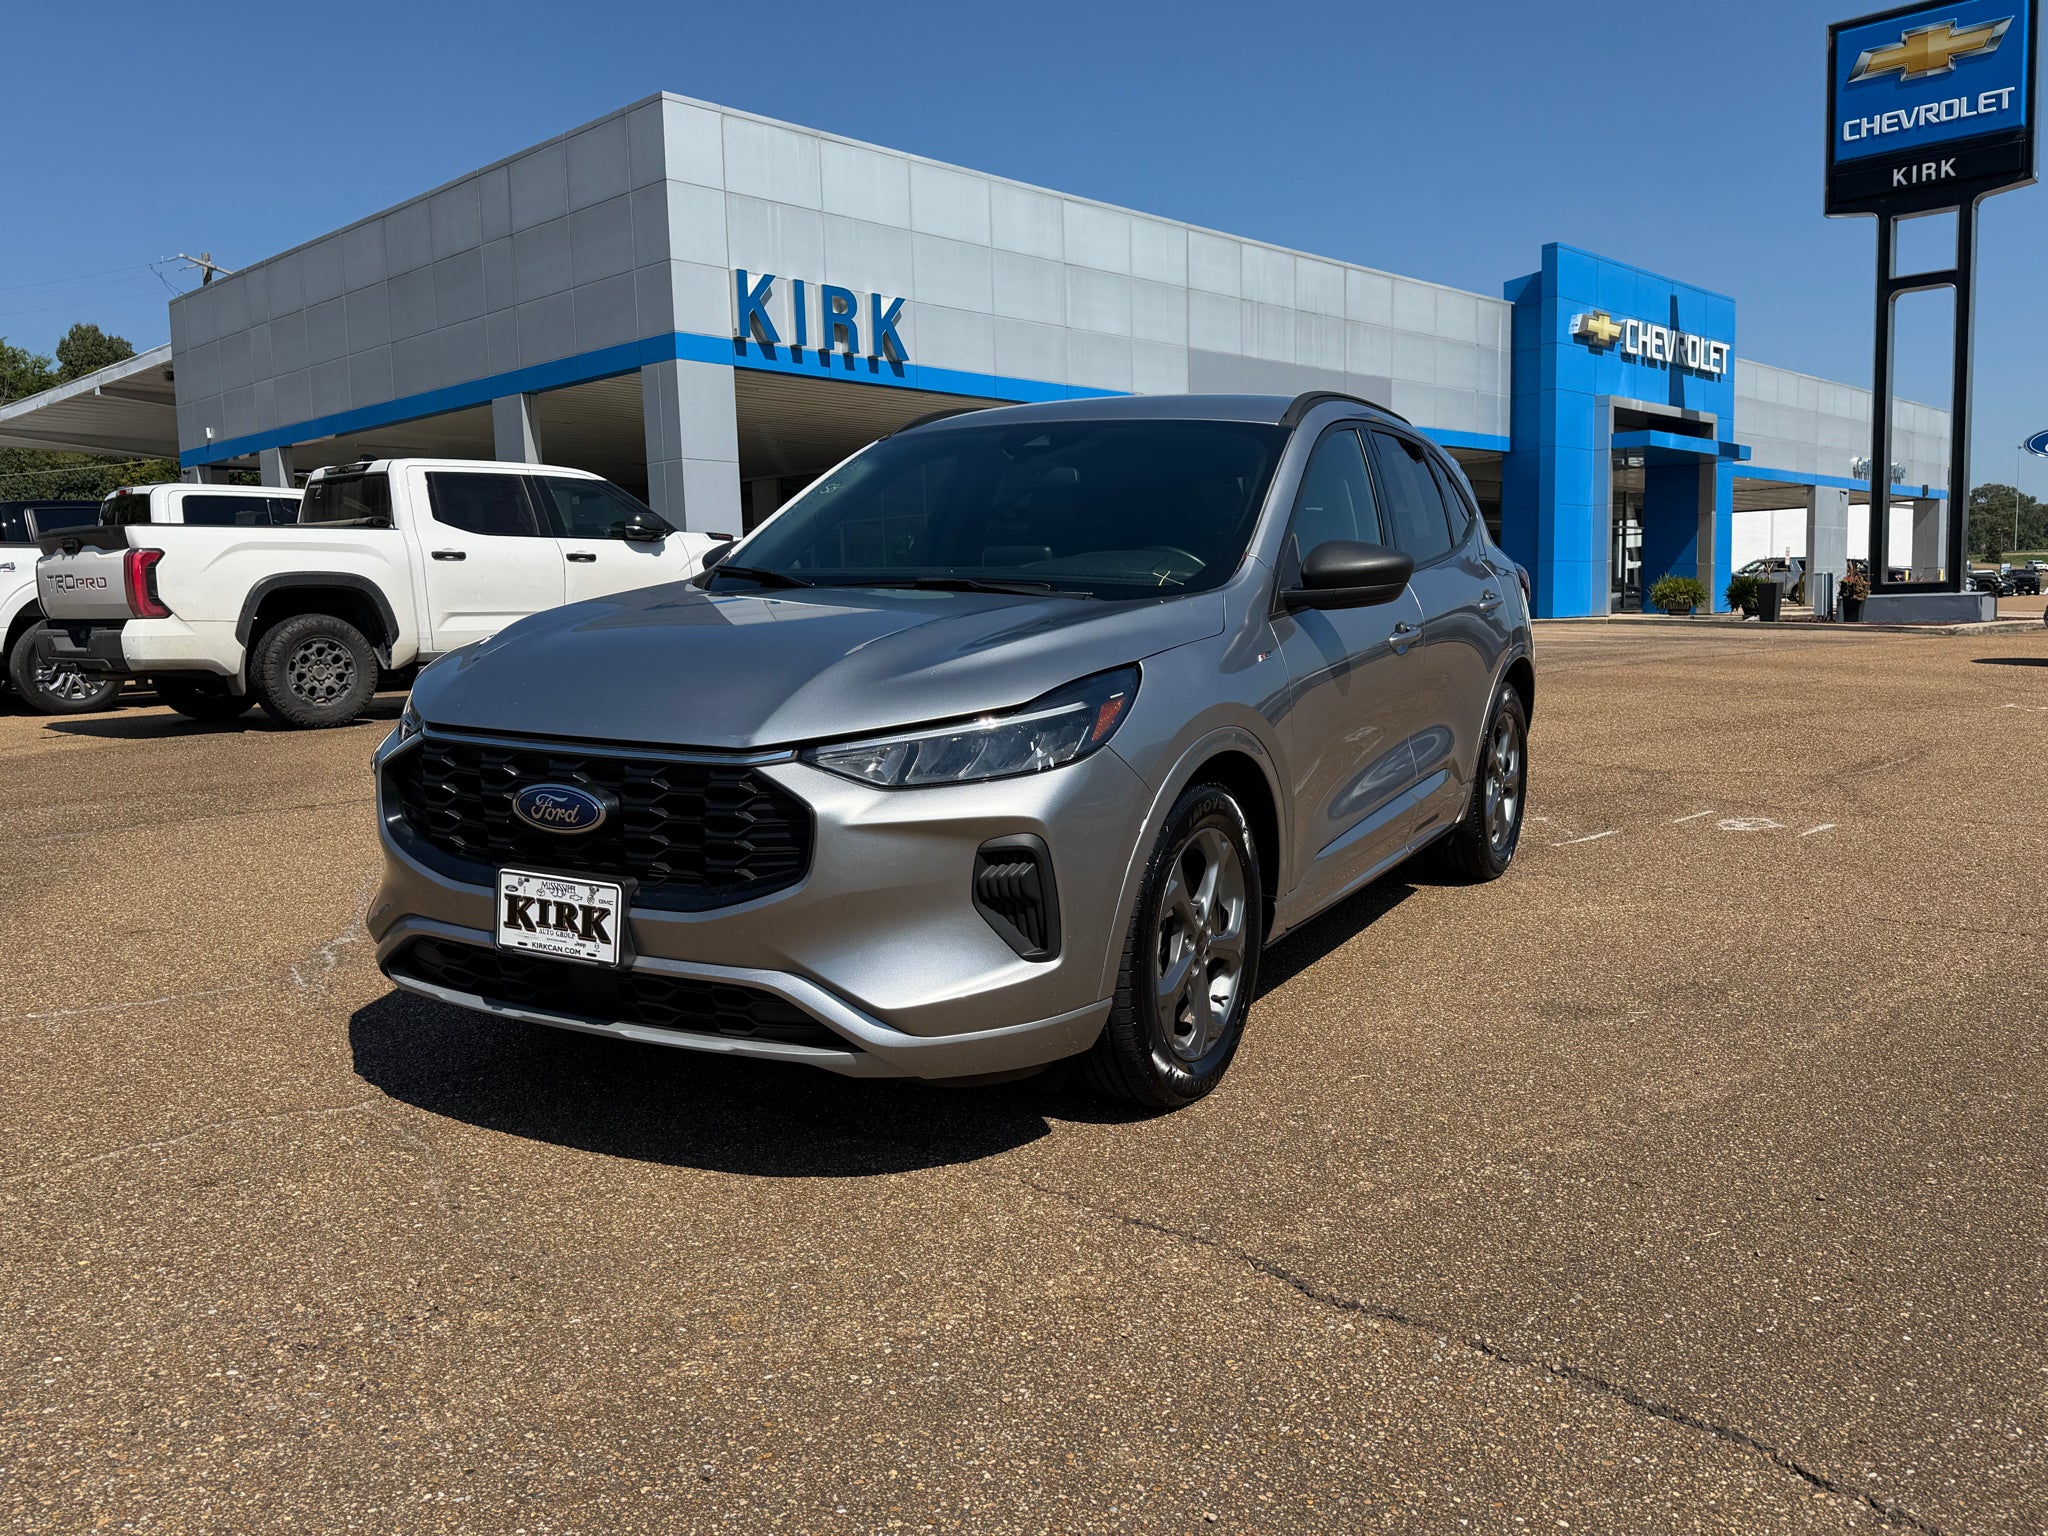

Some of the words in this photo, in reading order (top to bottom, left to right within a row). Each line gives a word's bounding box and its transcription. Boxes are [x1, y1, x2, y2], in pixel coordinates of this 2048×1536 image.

[1843, 86, 2015, 141] CHEVROLET
[1892, 157, 1957, 187] KIRK
[733, 268, 910, 361] KIRK
[1622, 317, 1731, 375] CHEVROLET
[46, 573, 76, 594] TRD
[76, 576, 108, 592] PRO
[530, 793, 581, 824] Ford
[503, 892, 612, 945] KIRK
[538, 928, 555, 937] AUTO
[555, 931, 576, 939] GROUP
[531, 941, 581, 956] KIRKCAN.COM
